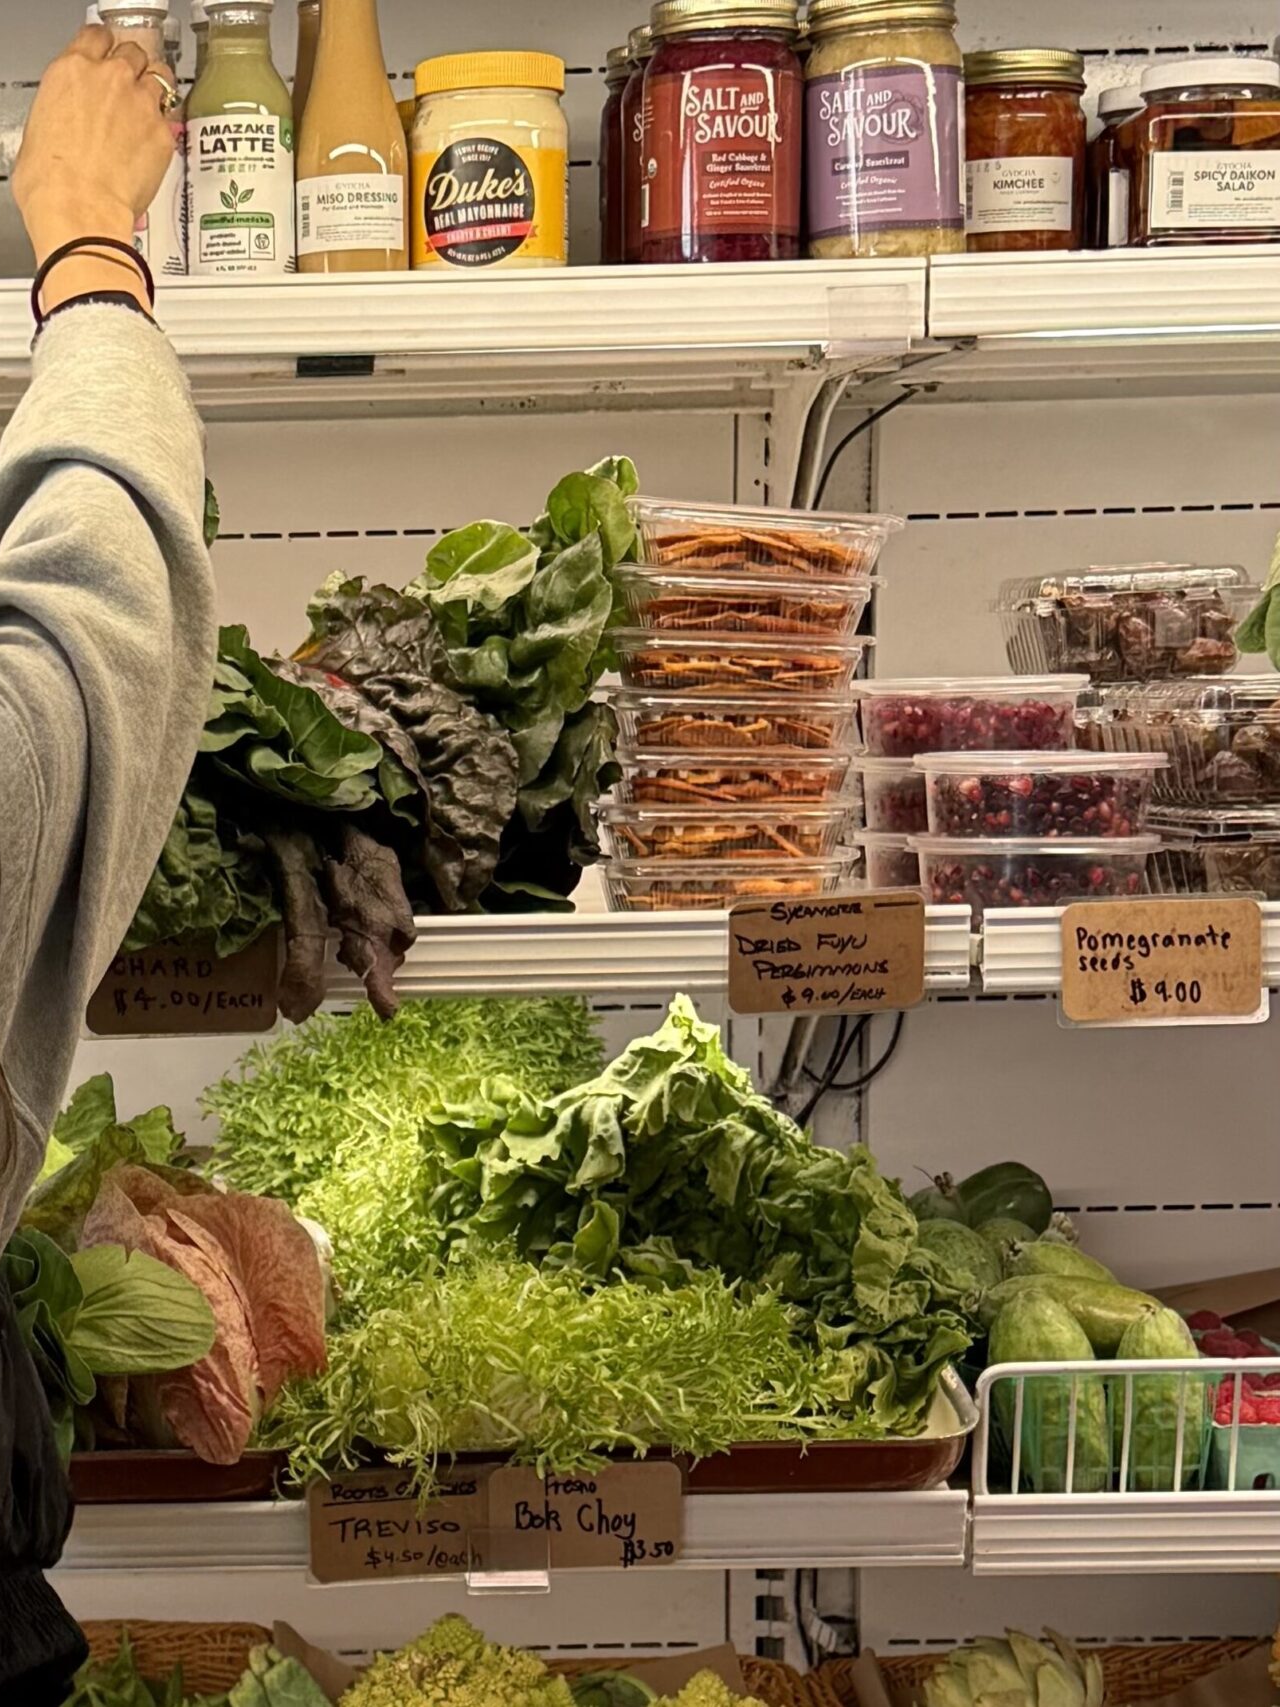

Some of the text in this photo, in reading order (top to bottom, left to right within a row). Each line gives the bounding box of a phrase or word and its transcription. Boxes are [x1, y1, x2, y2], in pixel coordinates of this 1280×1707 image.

[686, 85, 764, 117] SALT AND
[820, 89, 892, 120] SALT AND
[199, 124, 275, 137] AMAZAKE
[695, 113, 782, 144] SAVOUR
[828, 108, 916, 146] SAVOUR
[199, 137, 275, 155] LATTE
[712, 153, 726, 161] Red
[993, 178, 1044, 189] KIMCHEE
[1194, 170, 1275, 181] SPICY DAIKON
[1217, 181, 1255, 191] SALAD
[317, 192, 398, 205] MISO DRESSING
[429, 167, 527, 211] Duke's
[434, 203, 524, 231] REAL MAYONNAISE
[734, 933, 867, 956] DRIED FUYU
[1076, 925, 1231, 958] Pomegranate
[113, 956, 213, 978] CHARD
[752, 960, 889, 980] PERSIMMONS
[1078, 953, 1134, 972] seeds
[331, 1484, 389, 1500] ROOTS
[515, 1498, 636, 1539] Bok Choy
[329, 1517, 460, 1543] TREVISO
